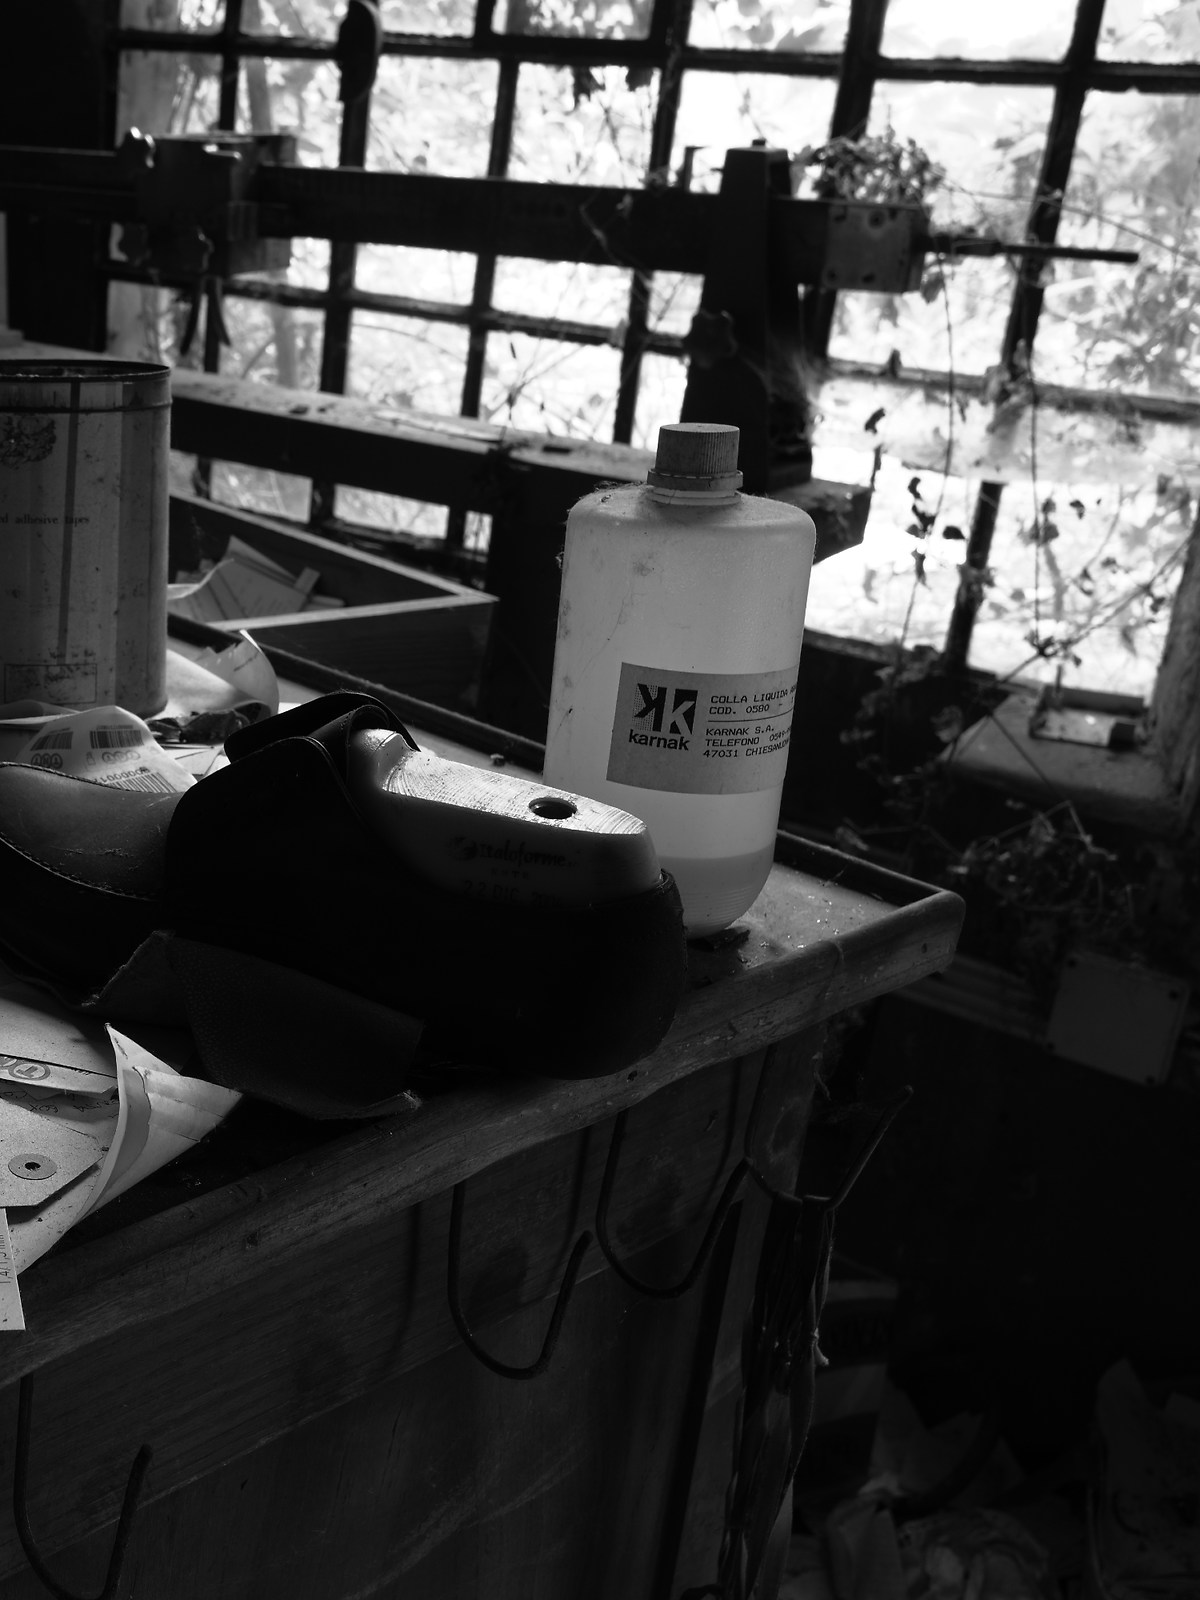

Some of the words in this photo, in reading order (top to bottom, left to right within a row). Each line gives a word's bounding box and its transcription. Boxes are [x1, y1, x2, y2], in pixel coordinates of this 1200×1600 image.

[15, 513, 59, 525] adhesive
[64, 515, 90, 528] tapes
[710, 695, 748, 704] COLLA
[753, 688, 789, 703] LIQUIDA
[709, 706, 737, 715] COD.
[745, 703, 770, 714] 0580
[705, 727, 750, 737] KARNAK
[754, 724, 775, 735] S.A.
[628, 729, 690, 751] karnak
[705, 736, 760, 747] TELEFONO
[703, 749, 739, 759] 47031
